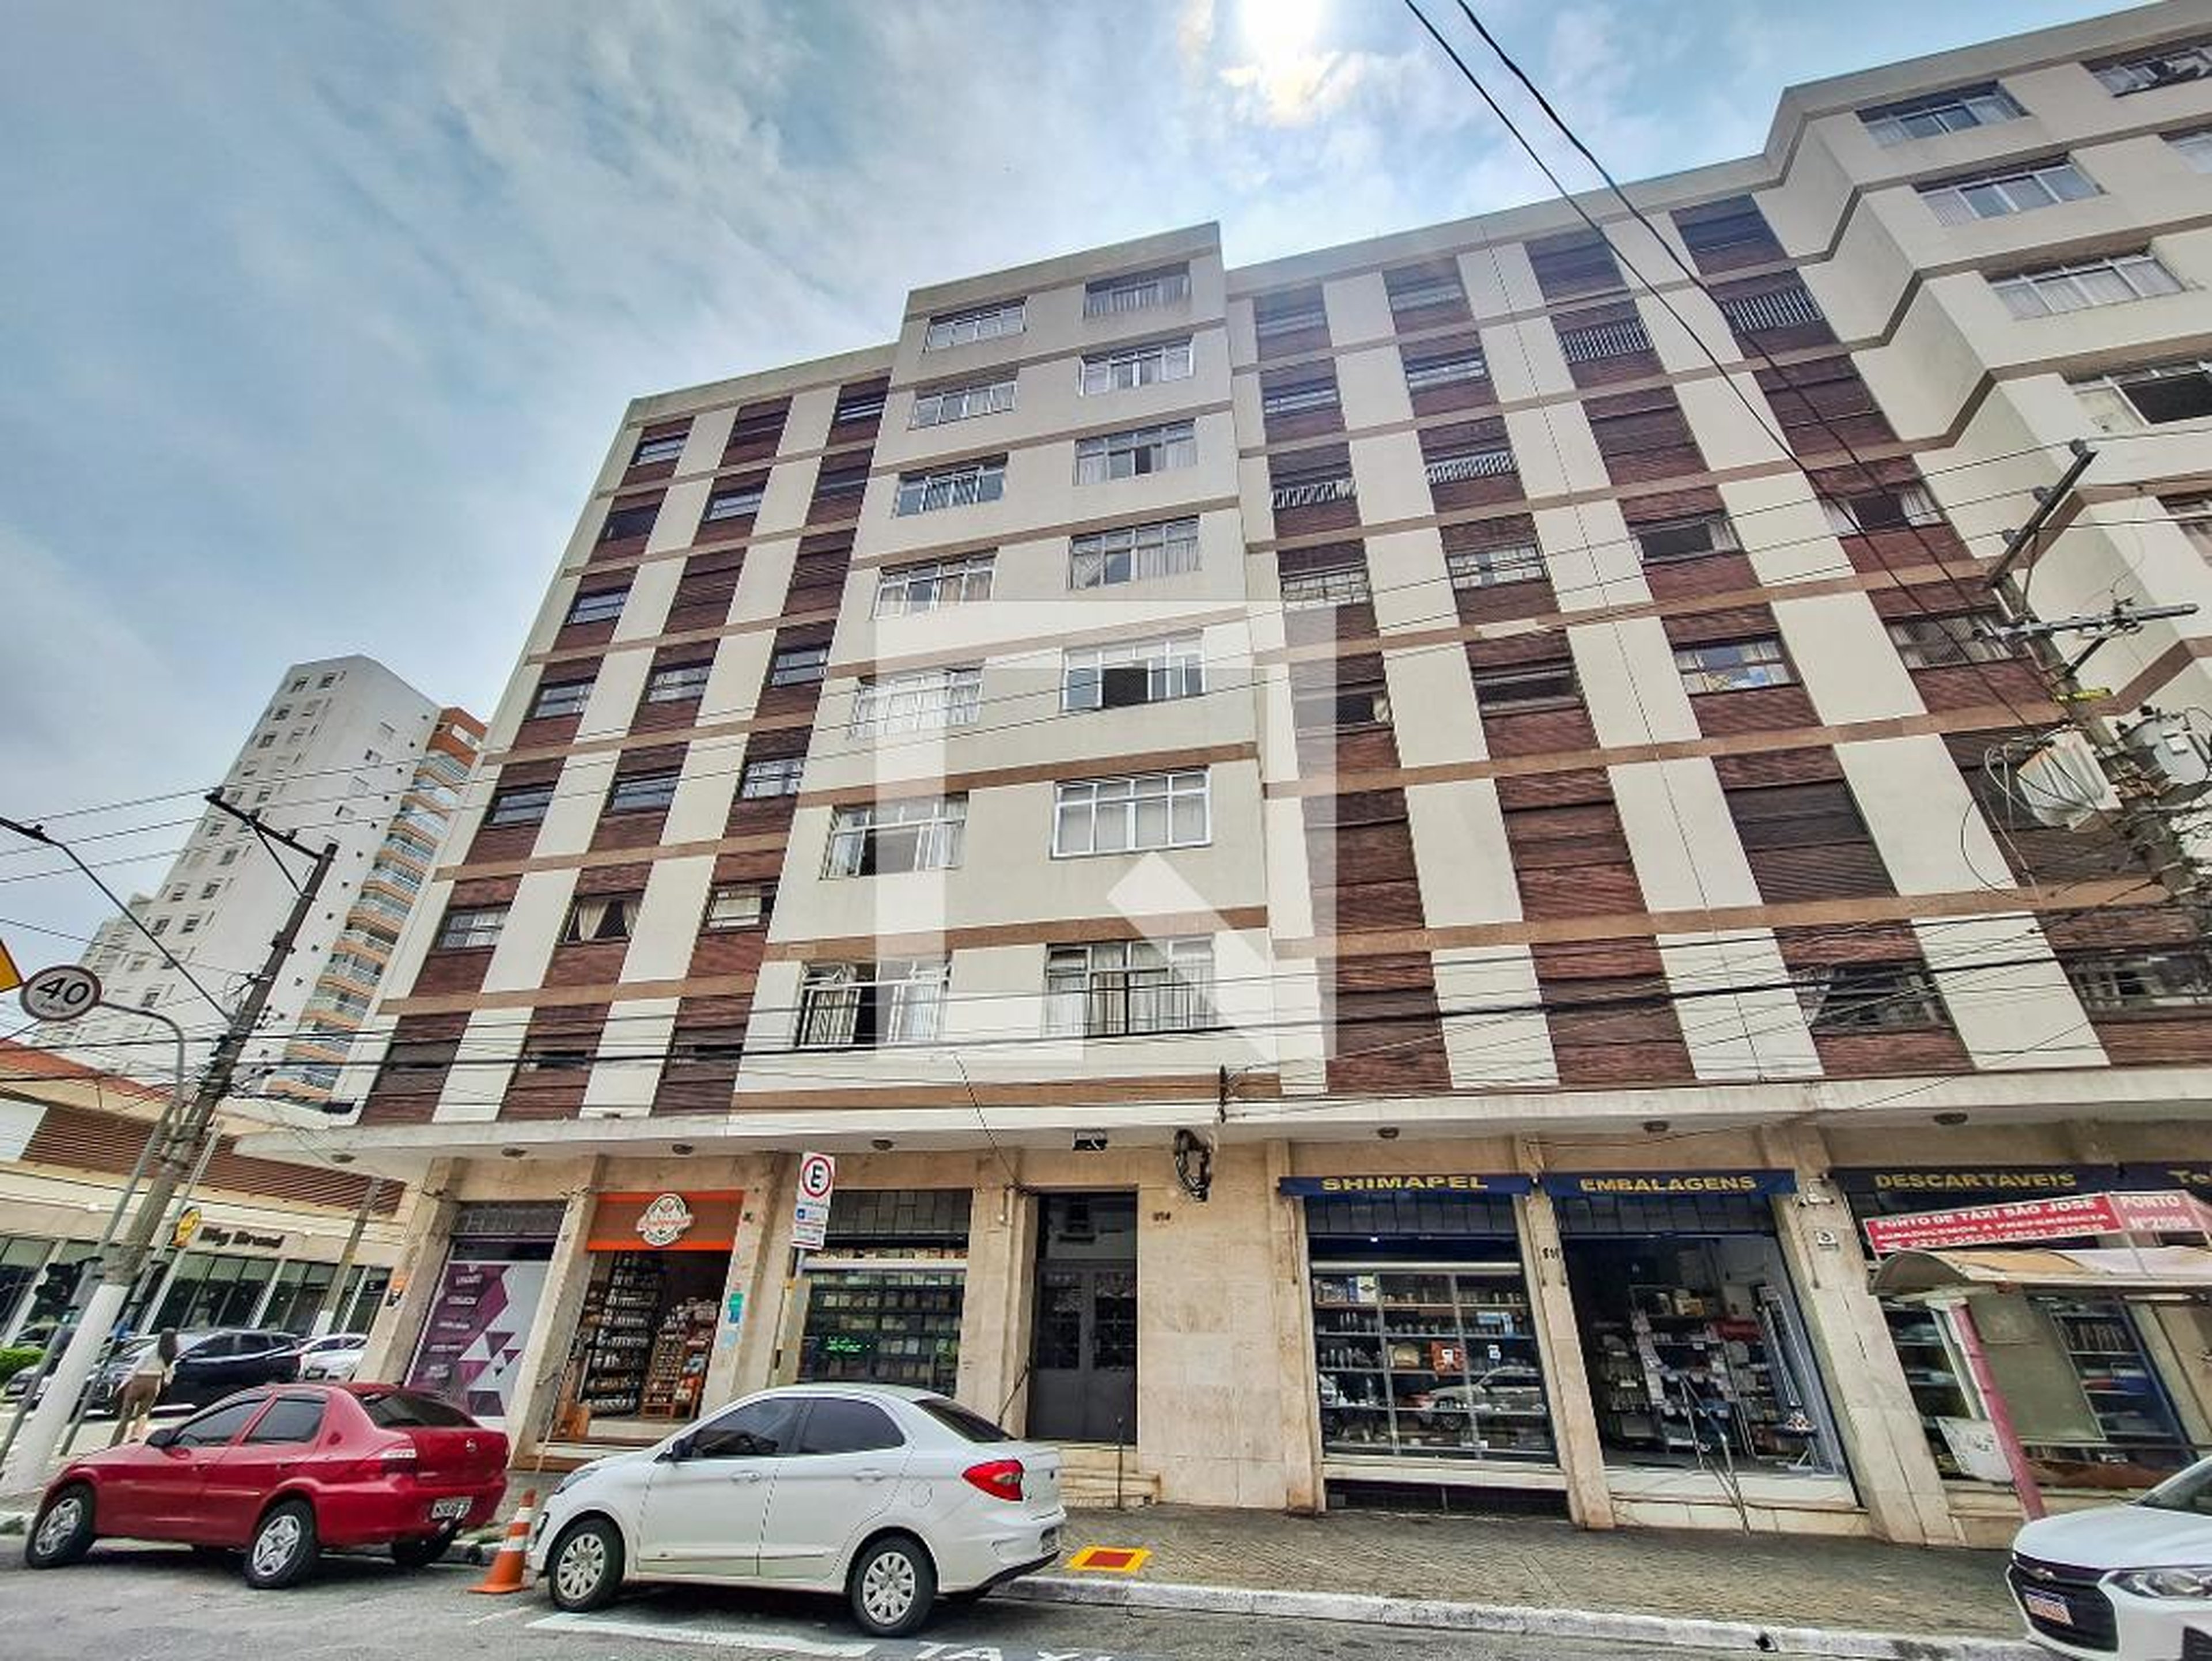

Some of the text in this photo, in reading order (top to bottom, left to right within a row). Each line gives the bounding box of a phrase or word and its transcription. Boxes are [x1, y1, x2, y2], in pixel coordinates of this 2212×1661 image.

[36, 977, 90, 1004] 40
[810, 1164, 824, 1189] E
[1322, 1176, 1488, 1190] SHIMAPEL
[1580, 1176, 1756, 1190] EMBALAGENS
[2167, 1170, 2212, 1185] Te
